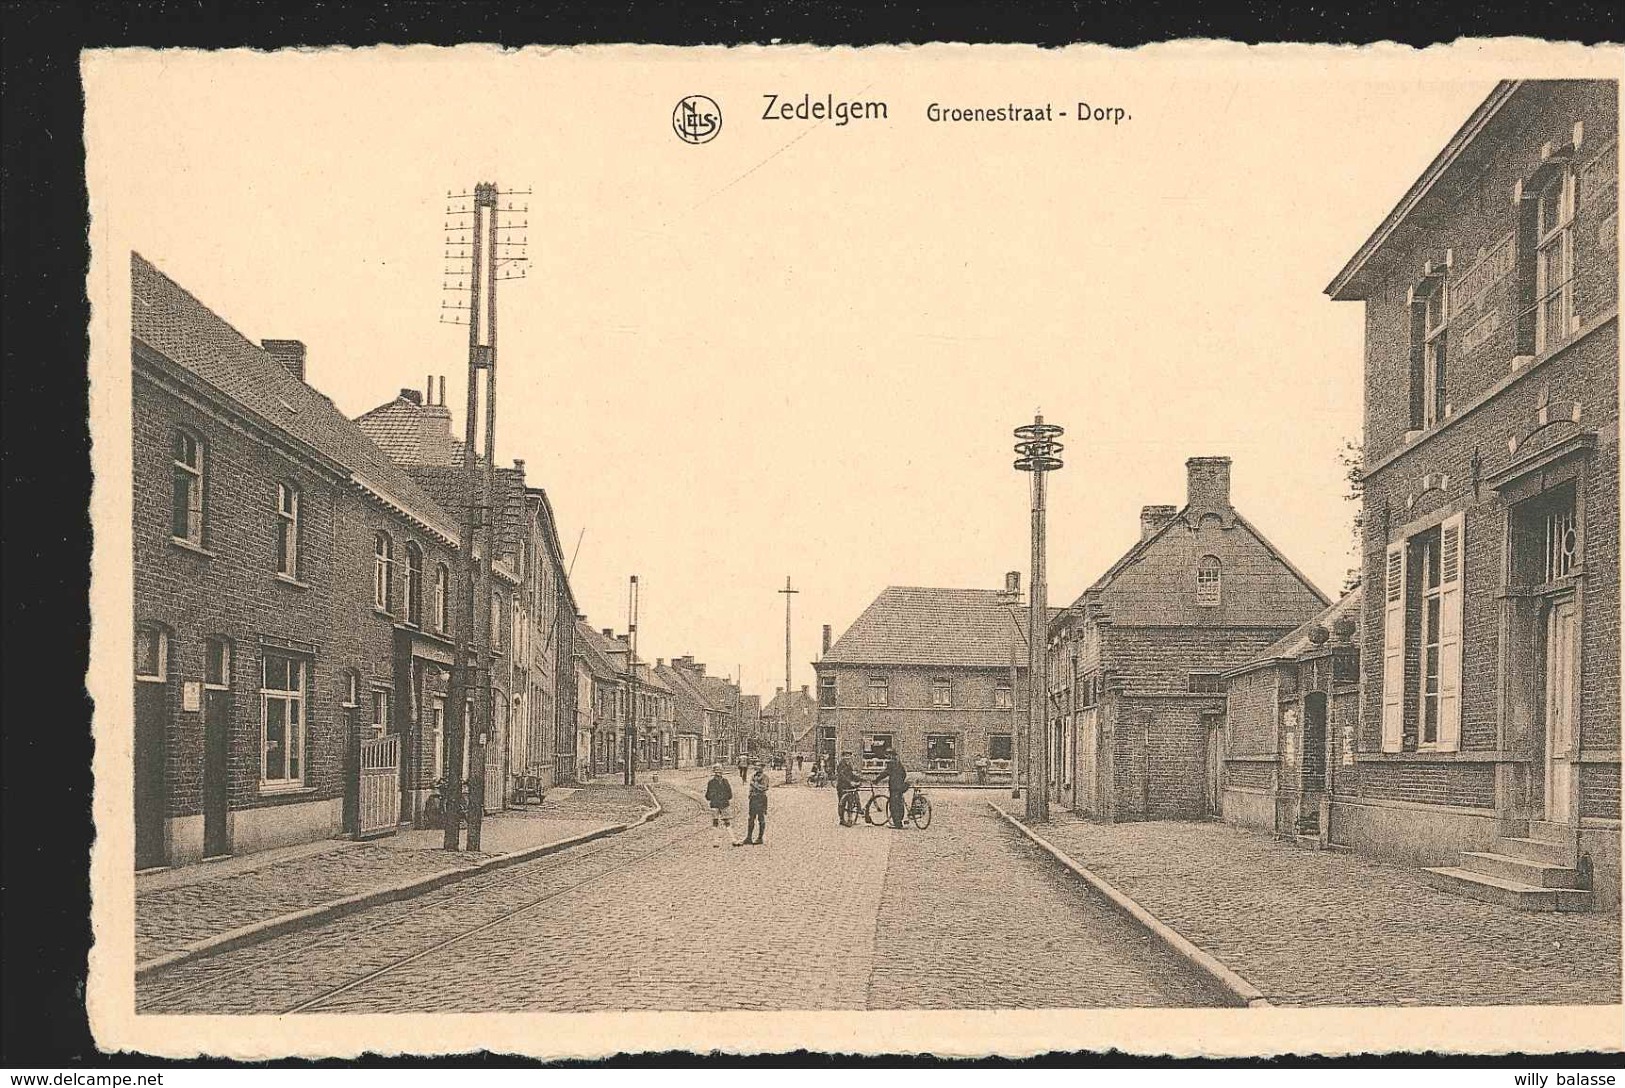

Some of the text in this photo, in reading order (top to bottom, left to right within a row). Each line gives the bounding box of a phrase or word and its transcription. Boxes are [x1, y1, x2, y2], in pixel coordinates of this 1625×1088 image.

[761, 93, 888, 126] Zedelgem
[926, 103, 1053, 122] Groenestraat
[1077, 102, 1132, 125] Dorp.
